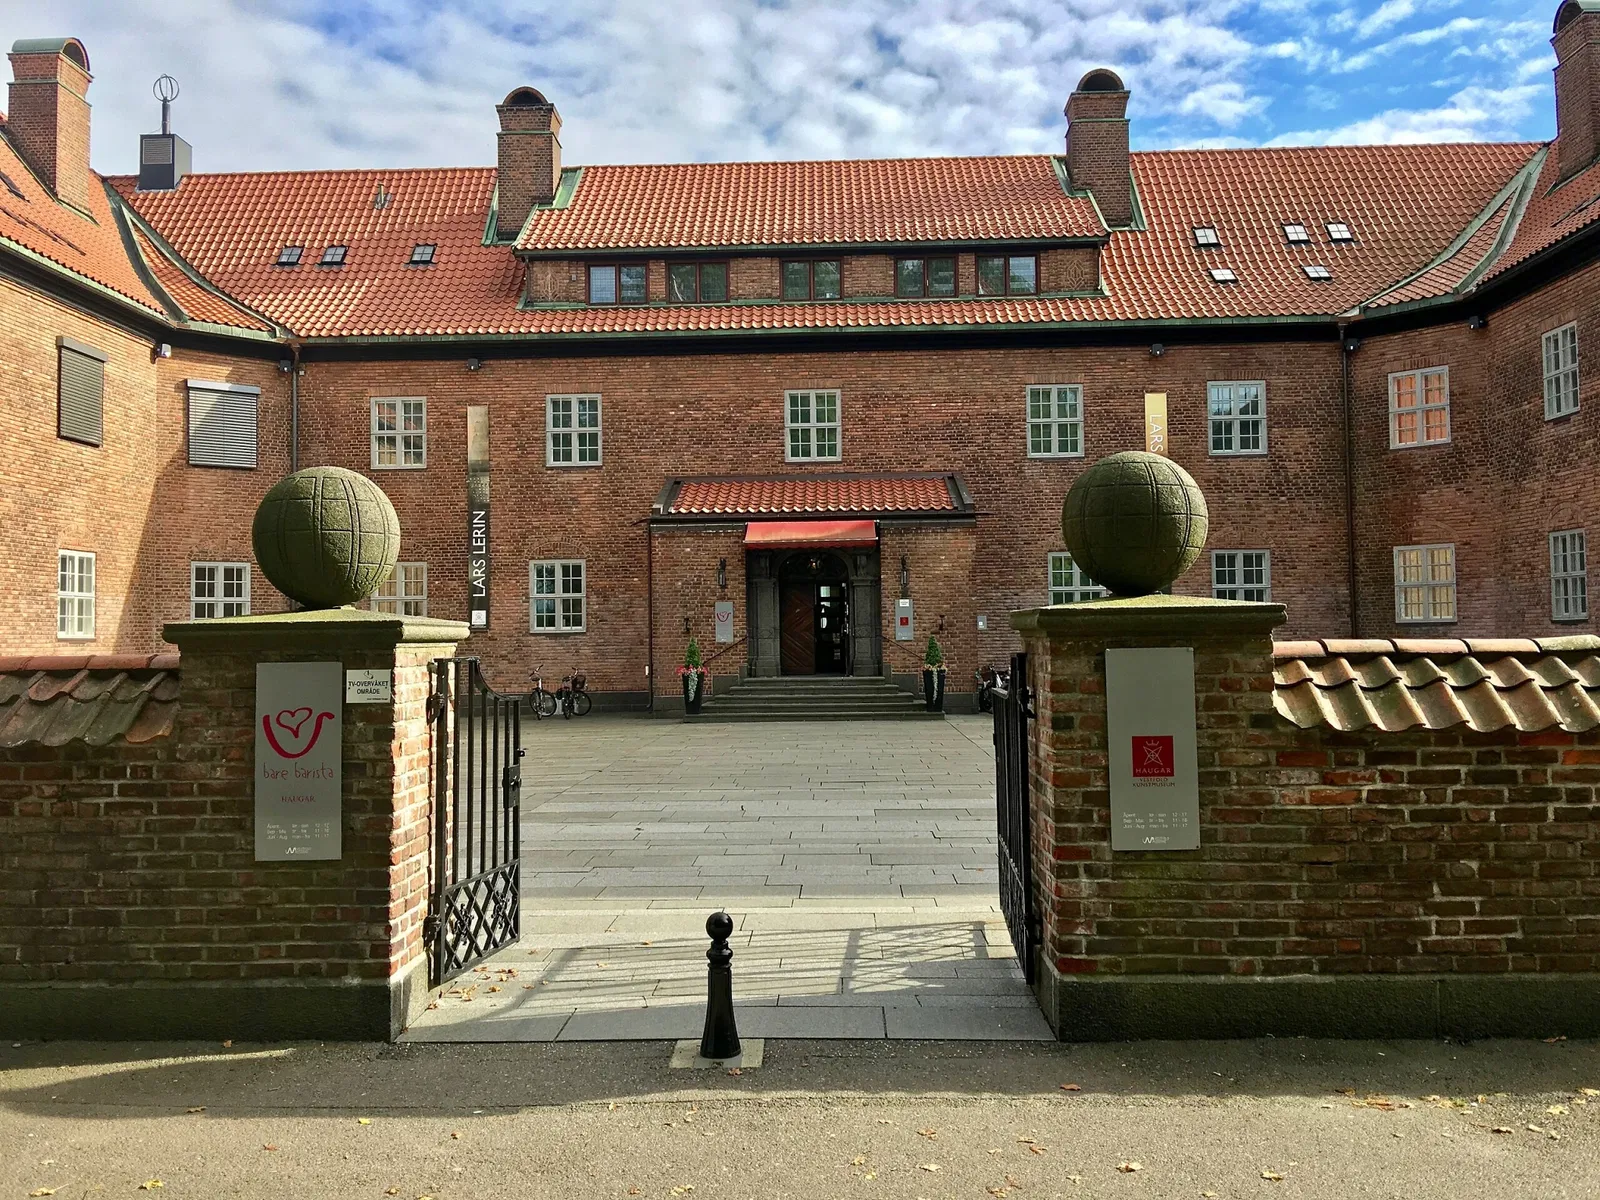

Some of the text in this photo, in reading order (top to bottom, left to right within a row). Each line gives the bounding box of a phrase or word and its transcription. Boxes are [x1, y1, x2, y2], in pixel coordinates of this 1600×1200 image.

[1149, 414, 1164, 452] LARS
[472, 510, 486, 597] LARS LERIN
[263, 762, 334, 781] bare barista
[281, 795, 316, 803] HAUGAR
